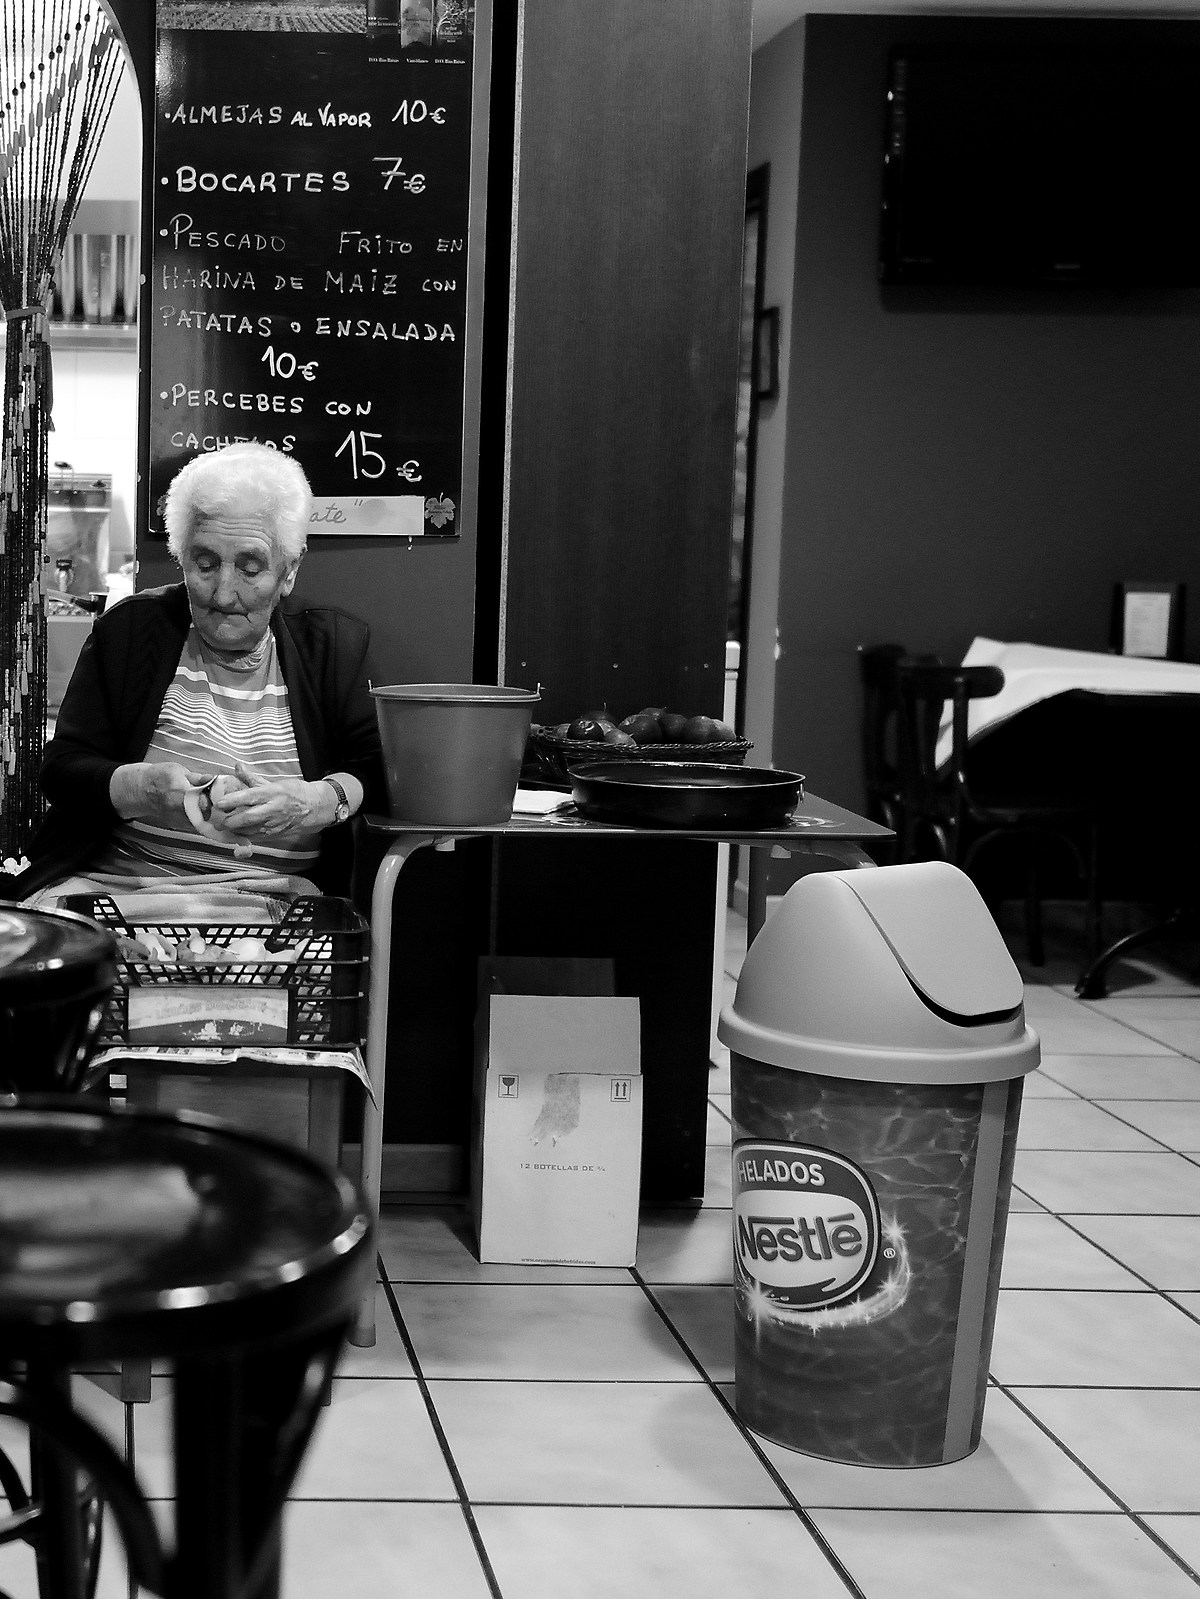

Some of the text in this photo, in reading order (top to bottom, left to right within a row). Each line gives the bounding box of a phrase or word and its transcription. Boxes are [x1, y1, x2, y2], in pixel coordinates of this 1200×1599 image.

[171, 99, 447, 128] ALMEJAS AL VAPOR 10€
[175, 156, 427, 195] BOCARTES 7€
[169, 213, 464, 255] PESCADO FRITO EN
[161, 264, 256, 291] HARINA
[274, 274, 304, 291] DE
[422, 278, 457, 292] CON
[159, 304, 273, 338] PATATAS
[315, 316, 456, 342] ENSALADA
[261, 345, 319, 381] 10€
[171, 382, 372, 416] PERCEBES CON
[533, 1163, 579, 1172] BOTELLAS
[737, 1159, 827, 1187] HELADOS
[737, 1212, 863, 1263] Nestlé
